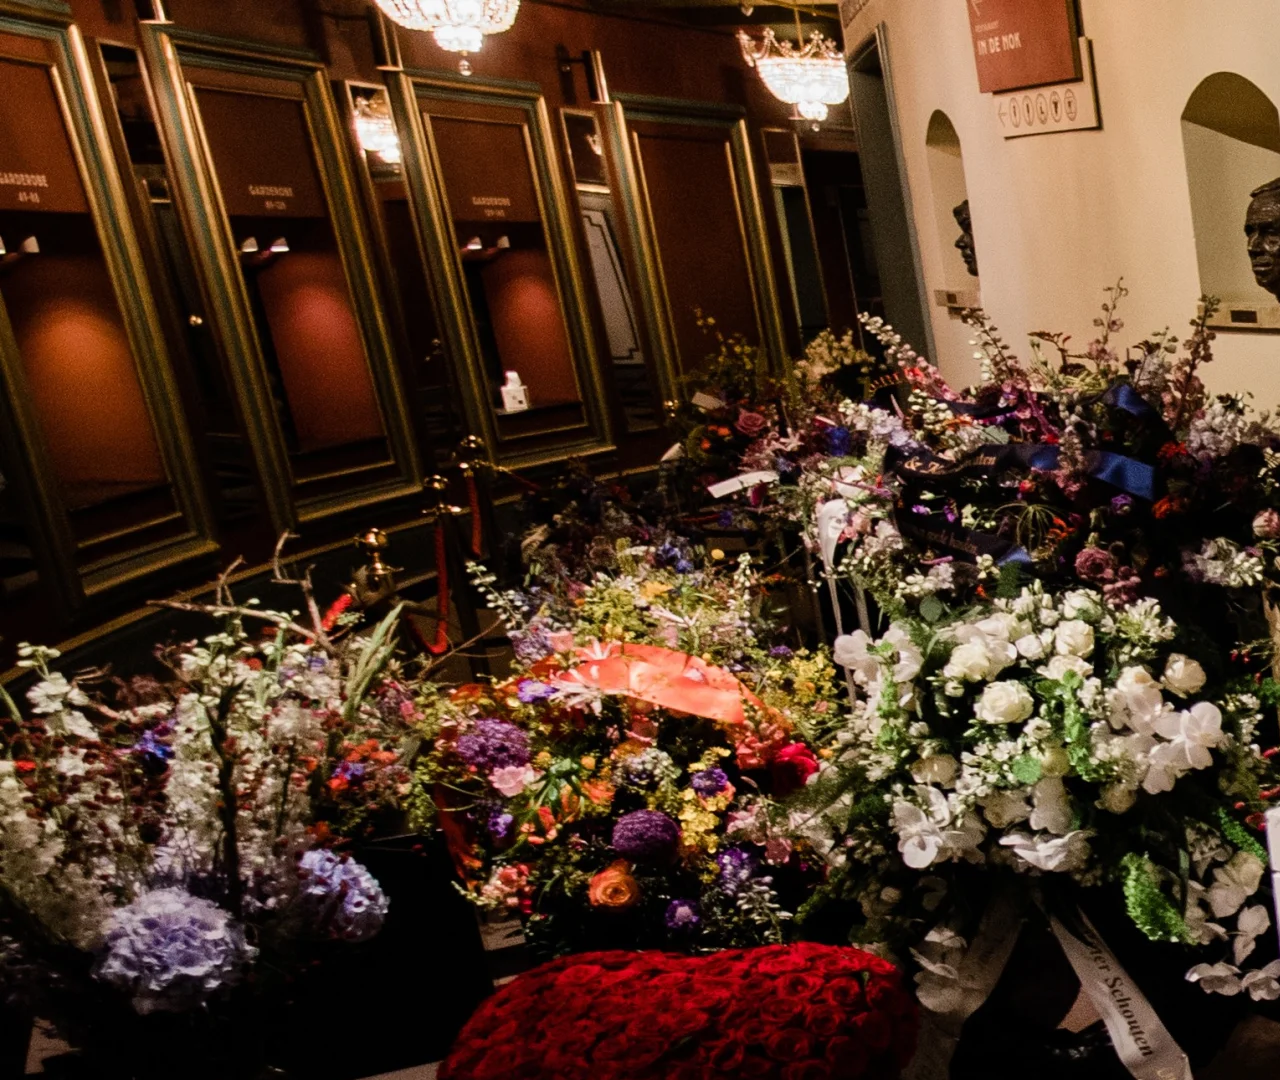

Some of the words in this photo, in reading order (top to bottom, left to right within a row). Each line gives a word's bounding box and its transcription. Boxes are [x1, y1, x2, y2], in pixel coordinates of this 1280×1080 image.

[976, 40, 987, 56] IN
[989, 37, 1001, 53] DE
[1003, 32, 1022, 51] NOK
[1104, 975, 1154, 1058] Schouten
